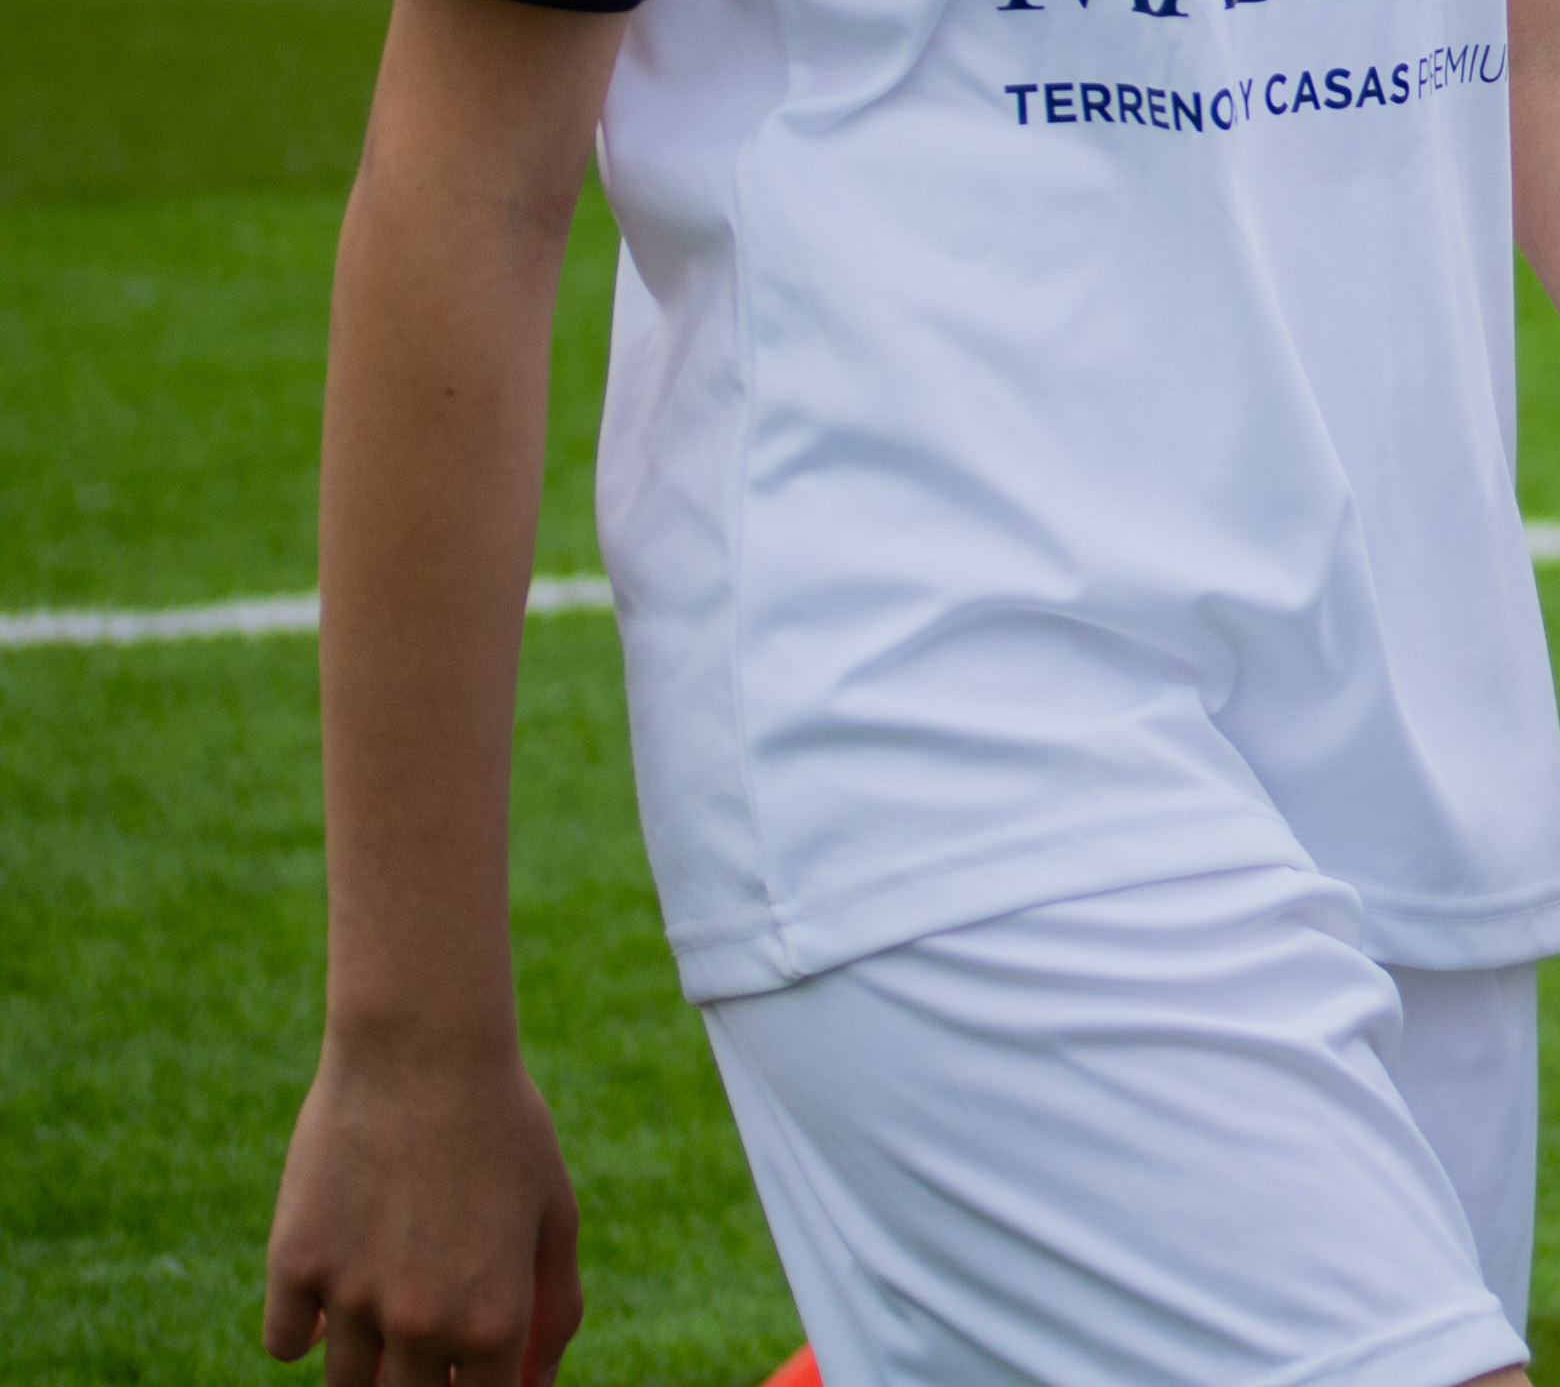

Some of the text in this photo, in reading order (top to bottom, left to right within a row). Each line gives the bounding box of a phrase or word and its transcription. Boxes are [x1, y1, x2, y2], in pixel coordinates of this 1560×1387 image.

[1004, 44, 1507, 133] TERRENO Y CASAS PEMIU
